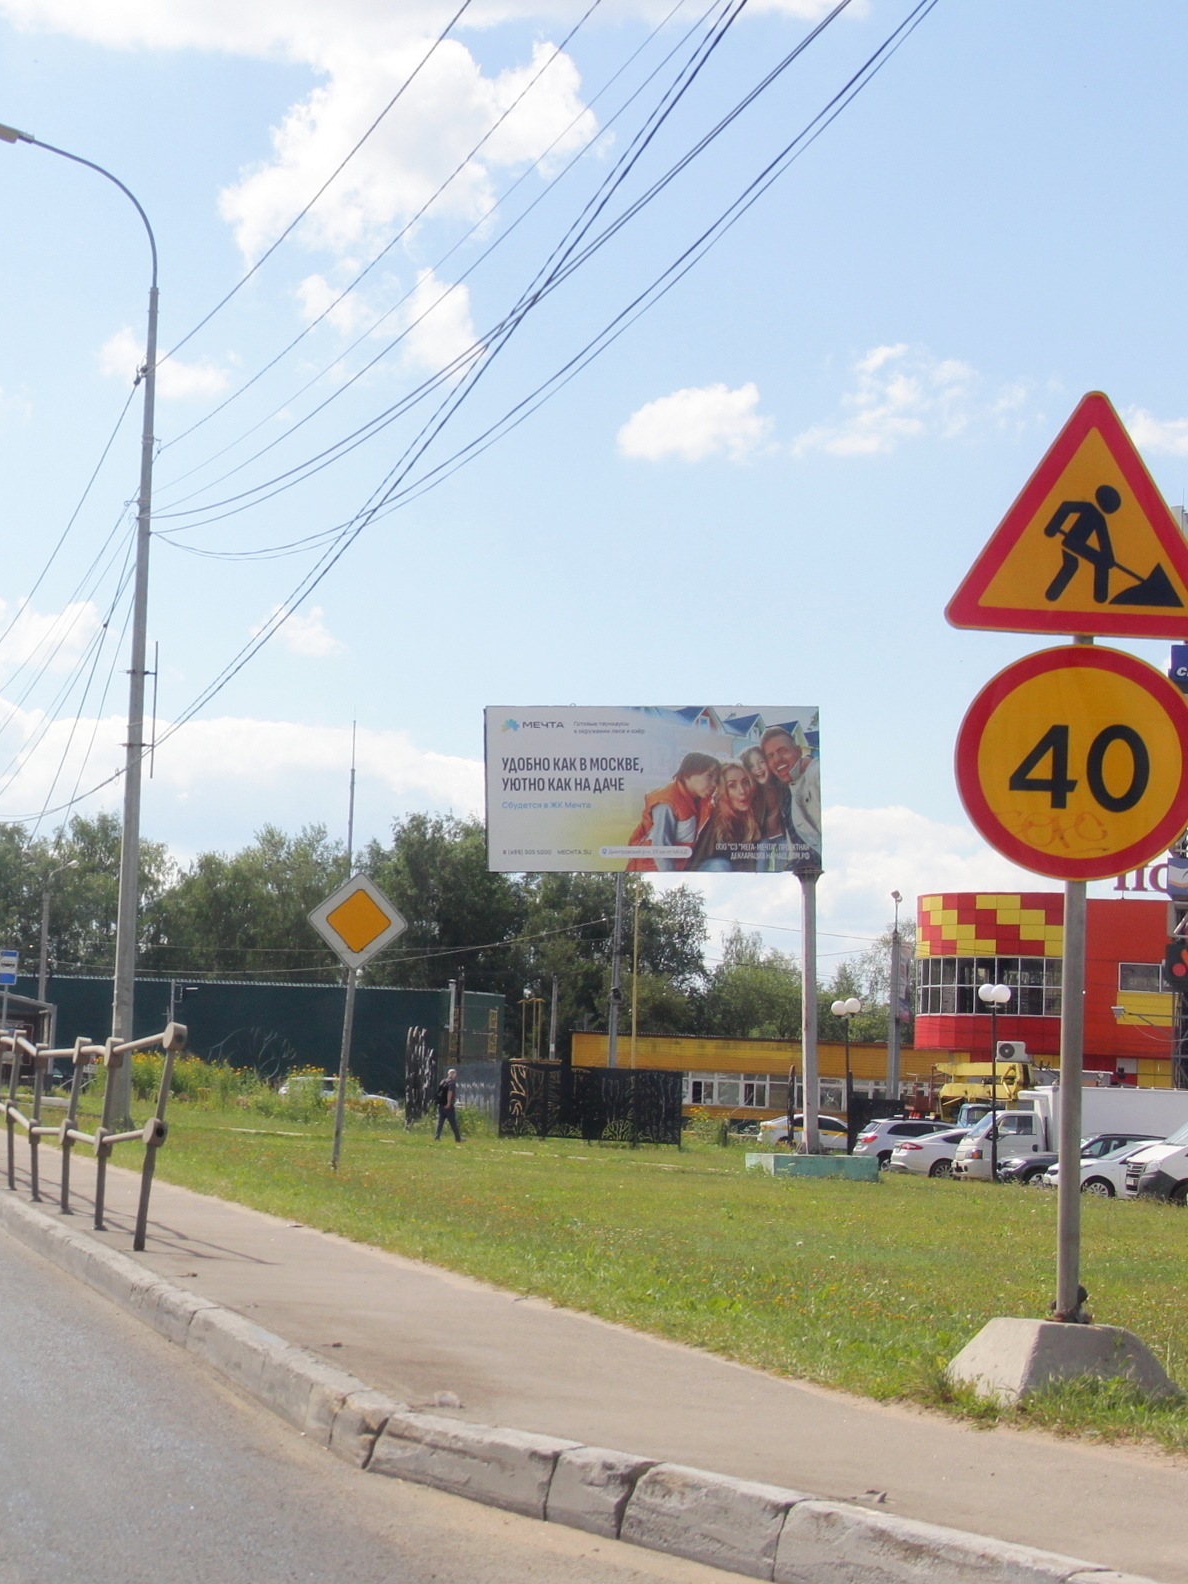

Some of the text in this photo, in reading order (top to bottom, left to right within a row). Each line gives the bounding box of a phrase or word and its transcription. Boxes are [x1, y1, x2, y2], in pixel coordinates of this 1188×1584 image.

[522, 721, 564, 729] МЕЧТА
[501, 757, 644, 773] УДОБНО КАК В МОСКВЕ,
[1008, 723, 1150, 813] 40
[501, 777, 625, 793] УЮТНО КАК НА ДАЧЕ
[502, 801, 542, 811] Сбудется
[550, 801, 563, 809] ЖК
[564, 801, 592, 809] Мечта
